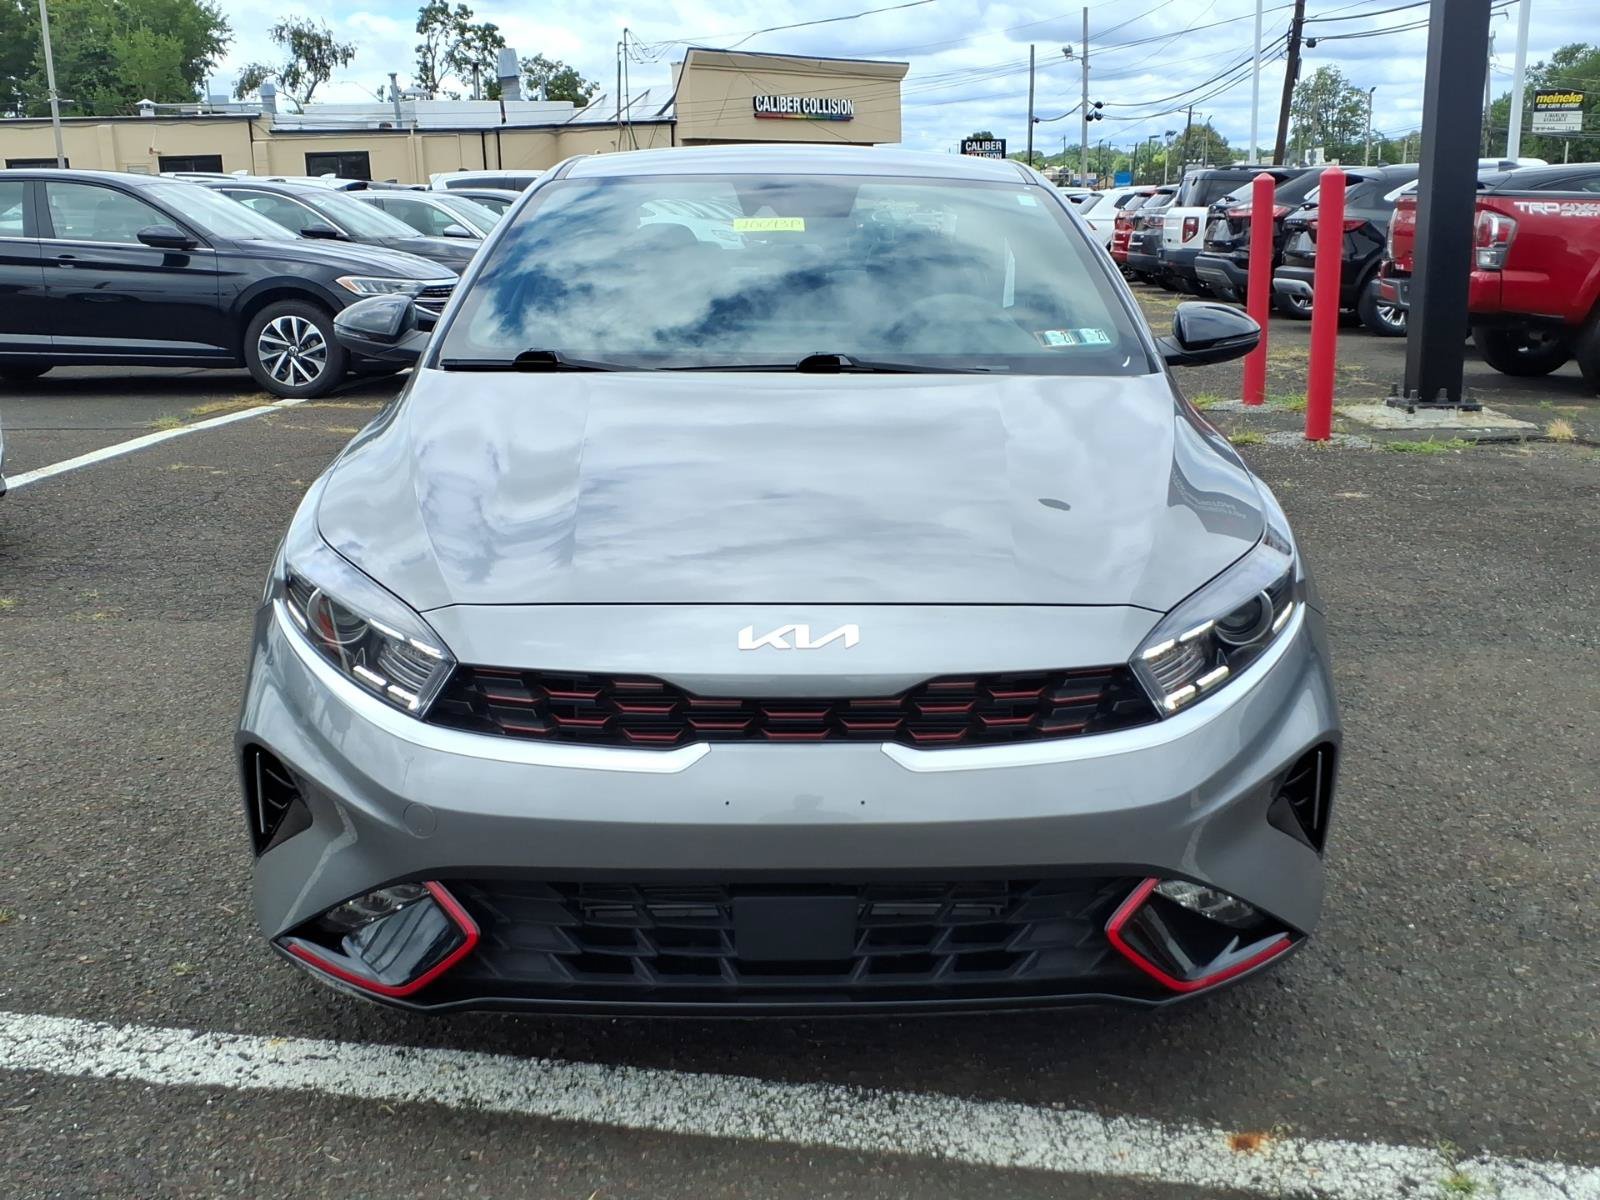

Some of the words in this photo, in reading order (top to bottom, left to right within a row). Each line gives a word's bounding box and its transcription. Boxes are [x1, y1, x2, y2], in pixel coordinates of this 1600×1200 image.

[1536, 92, 1584, 103] meineke
[755, 95, 800, 112] CALIBER
[802, 97, 854, 114] COLLISION
[965, 141, 1002, 151] CALIBER
[1513, 201, 1561, 215] TRD
